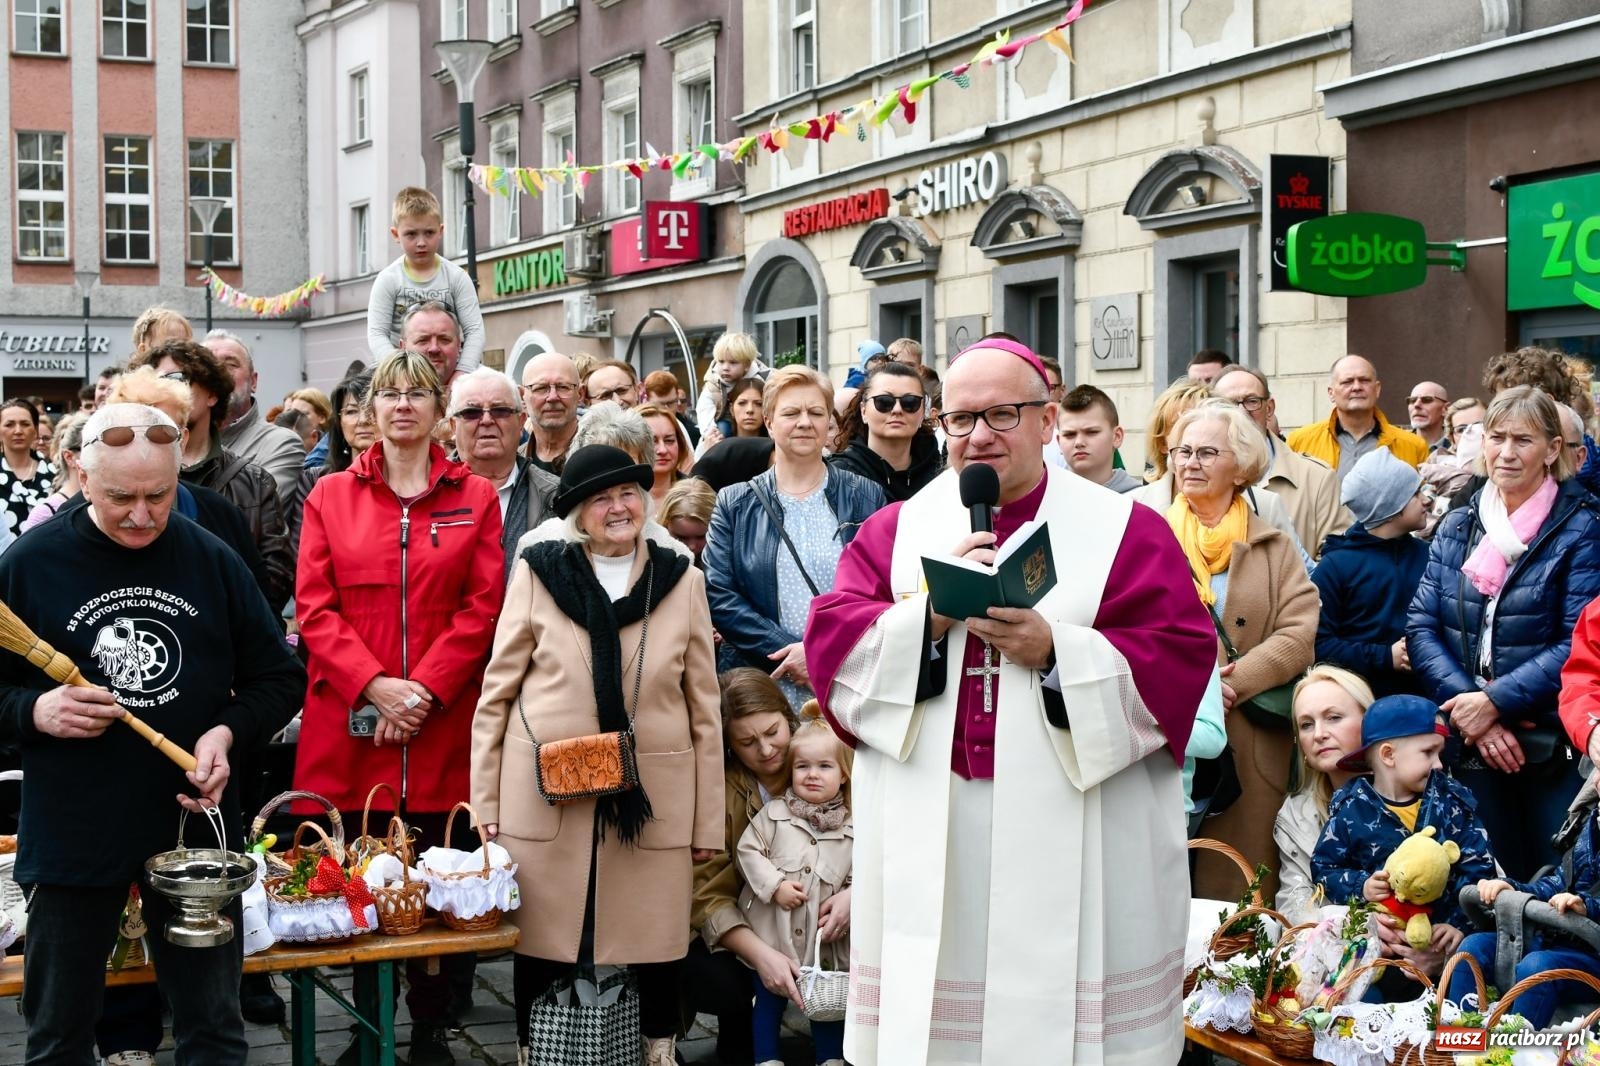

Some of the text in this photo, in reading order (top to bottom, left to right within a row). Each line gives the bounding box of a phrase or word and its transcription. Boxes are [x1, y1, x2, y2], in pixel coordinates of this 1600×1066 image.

[917, 151, 1003, 216] SHIRO
[1276, 194, 1323, 210] TYSKIE
[658, 209, 689, 250] T
[784, 188, 890, 237] RESTAURACJA
[1310, 232, 1415, 266] żabka
[494, 247, 566, 294] KANTOR
[66, 586, 199, 632] 25 ROZPOCZĘCIE SEZONU
[85, 599, 180, 627] MOTOCYKLOWEGO
[112, 687, 180, 708] Racibórz 2022
